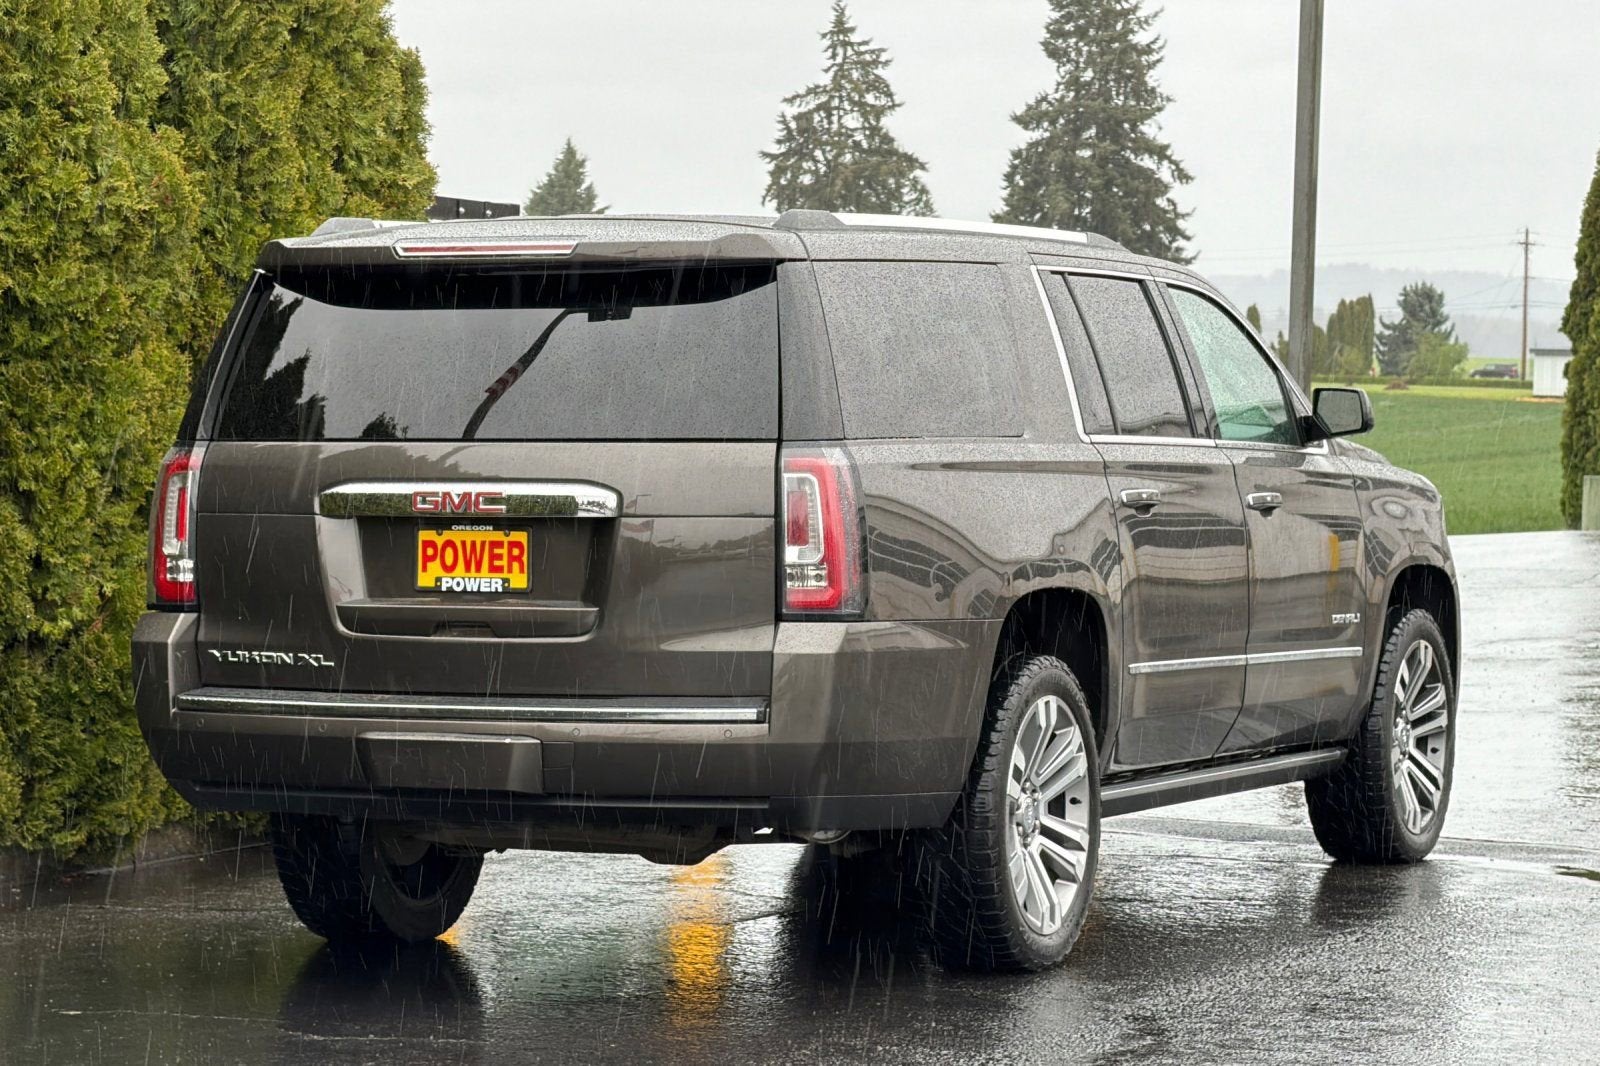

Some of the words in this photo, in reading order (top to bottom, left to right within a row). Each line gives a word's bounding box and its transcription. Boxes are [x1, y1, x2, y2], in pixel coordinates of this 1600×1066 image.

[412, 491, 506, 513] GMC
[421, 539, 525, 574] POWER
[441, 577, 503, 592] POWER
[208, 650, 294, 665] YUKON
[297, 653, 335, 667] XL
